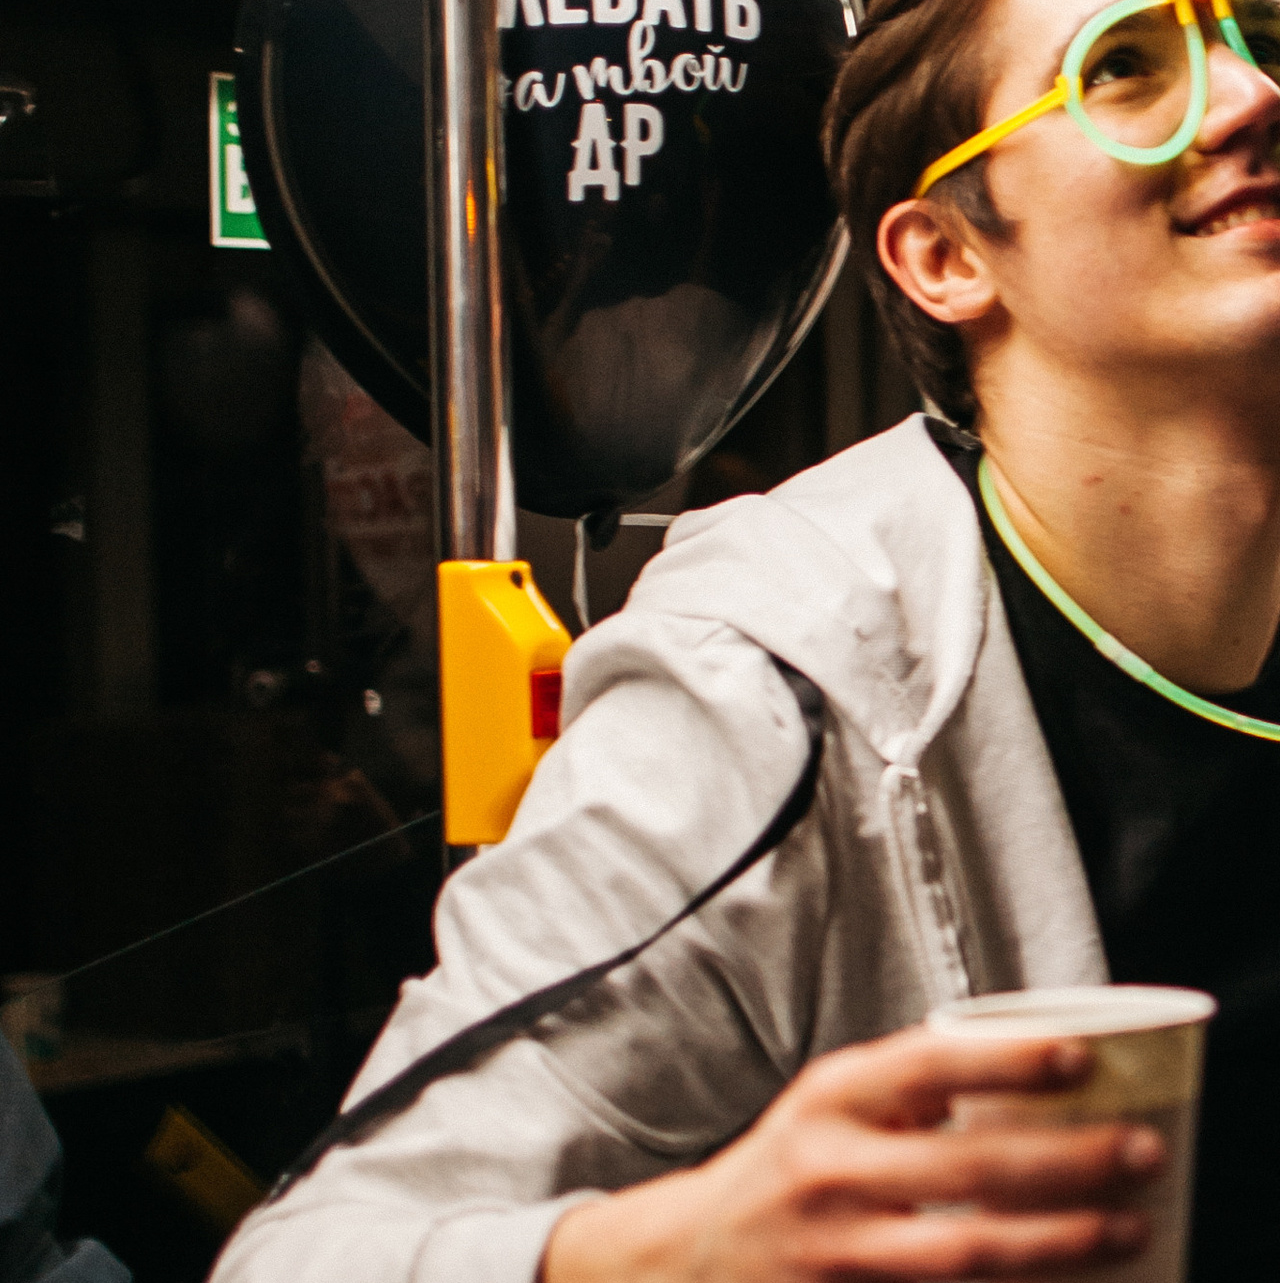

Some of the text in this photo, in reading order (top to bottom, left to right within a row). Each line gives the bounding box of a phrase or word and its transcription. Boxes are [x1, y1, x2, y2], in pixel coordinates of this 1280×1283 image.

[512, 19, 749, 112] а твой
[567, 102, 665, 202] ДР
